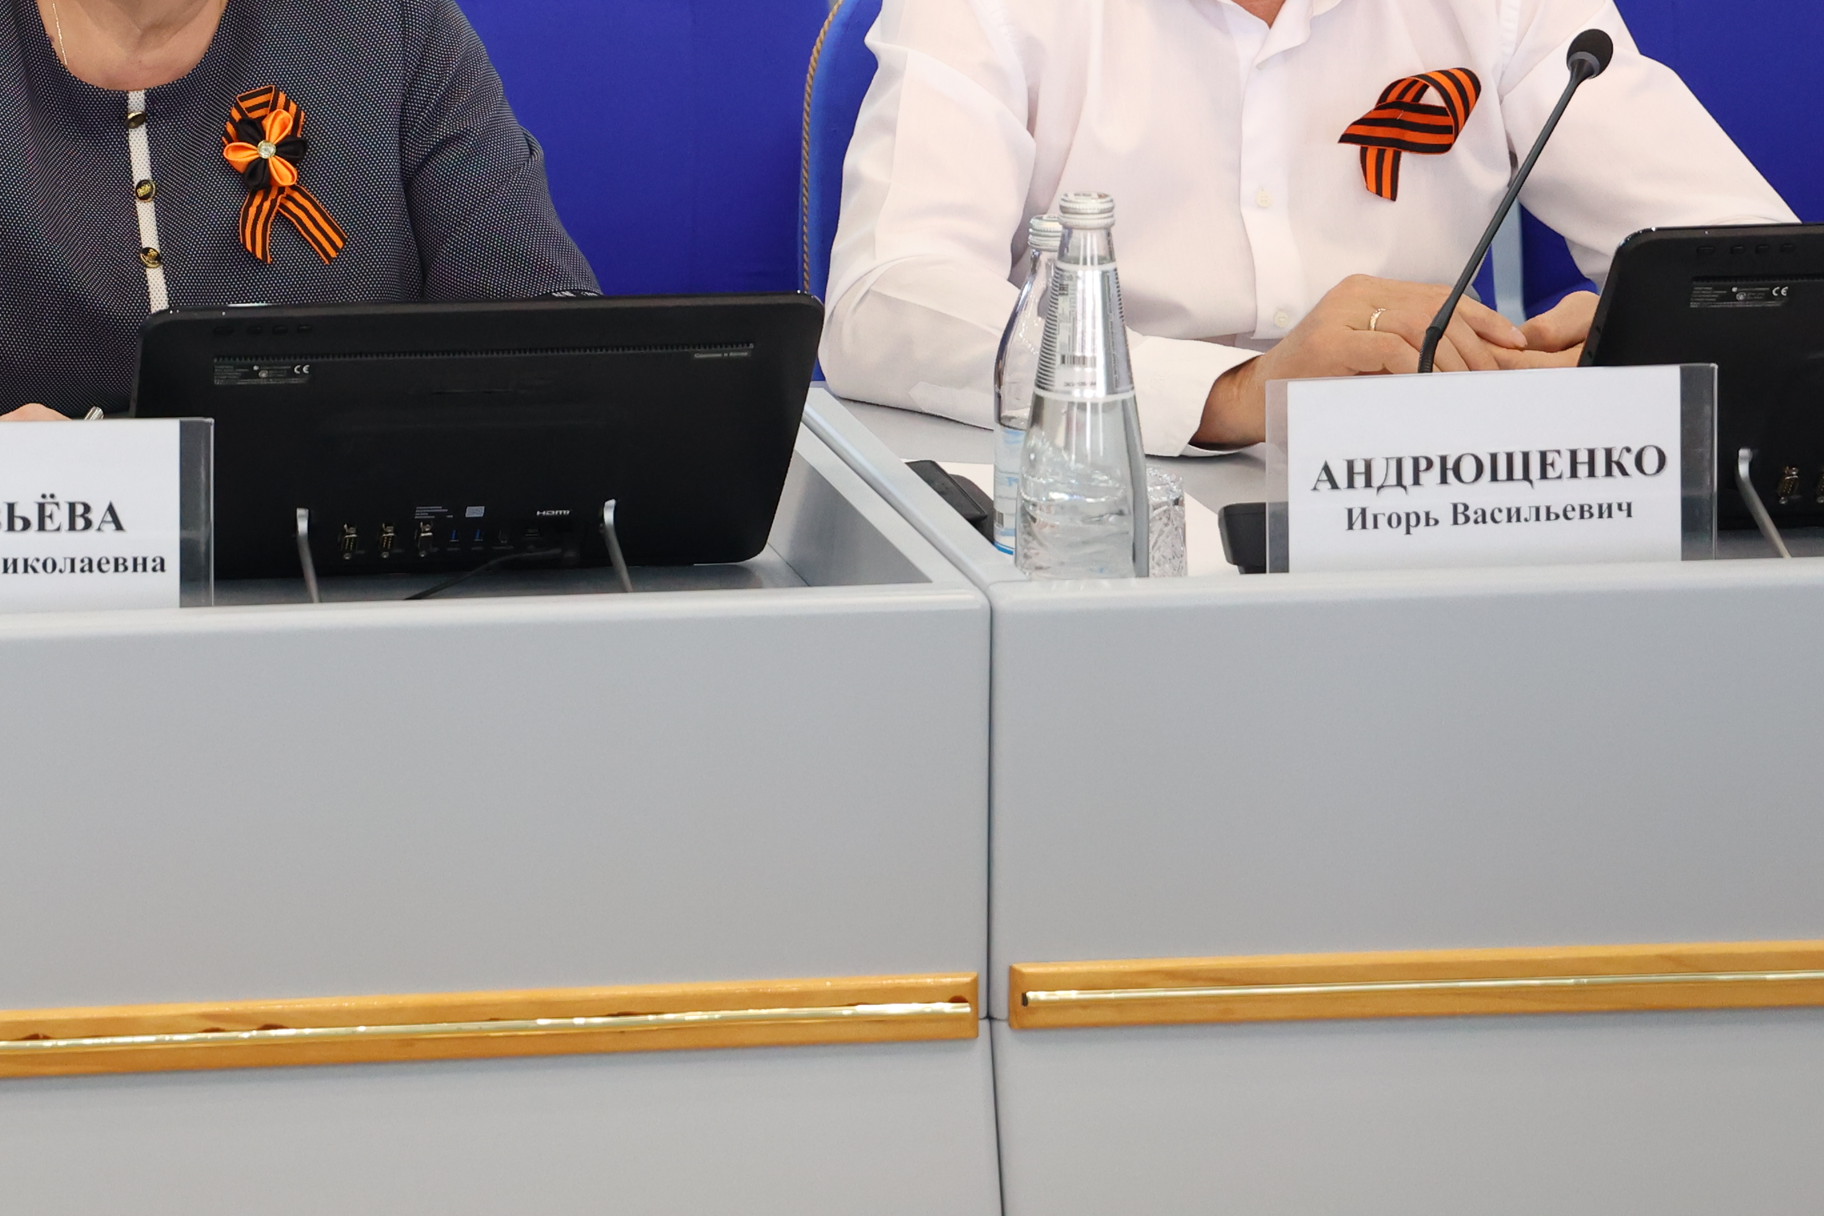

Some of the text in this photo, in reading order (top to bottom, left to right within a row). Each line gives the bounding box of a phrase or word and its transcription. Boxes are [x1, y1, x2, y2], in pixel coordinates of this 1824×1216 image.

[1311, 445, 1668, 495] АНДРЮЩЕНКО
[1345, 501, 1635, 536] Игорь Васильевич
